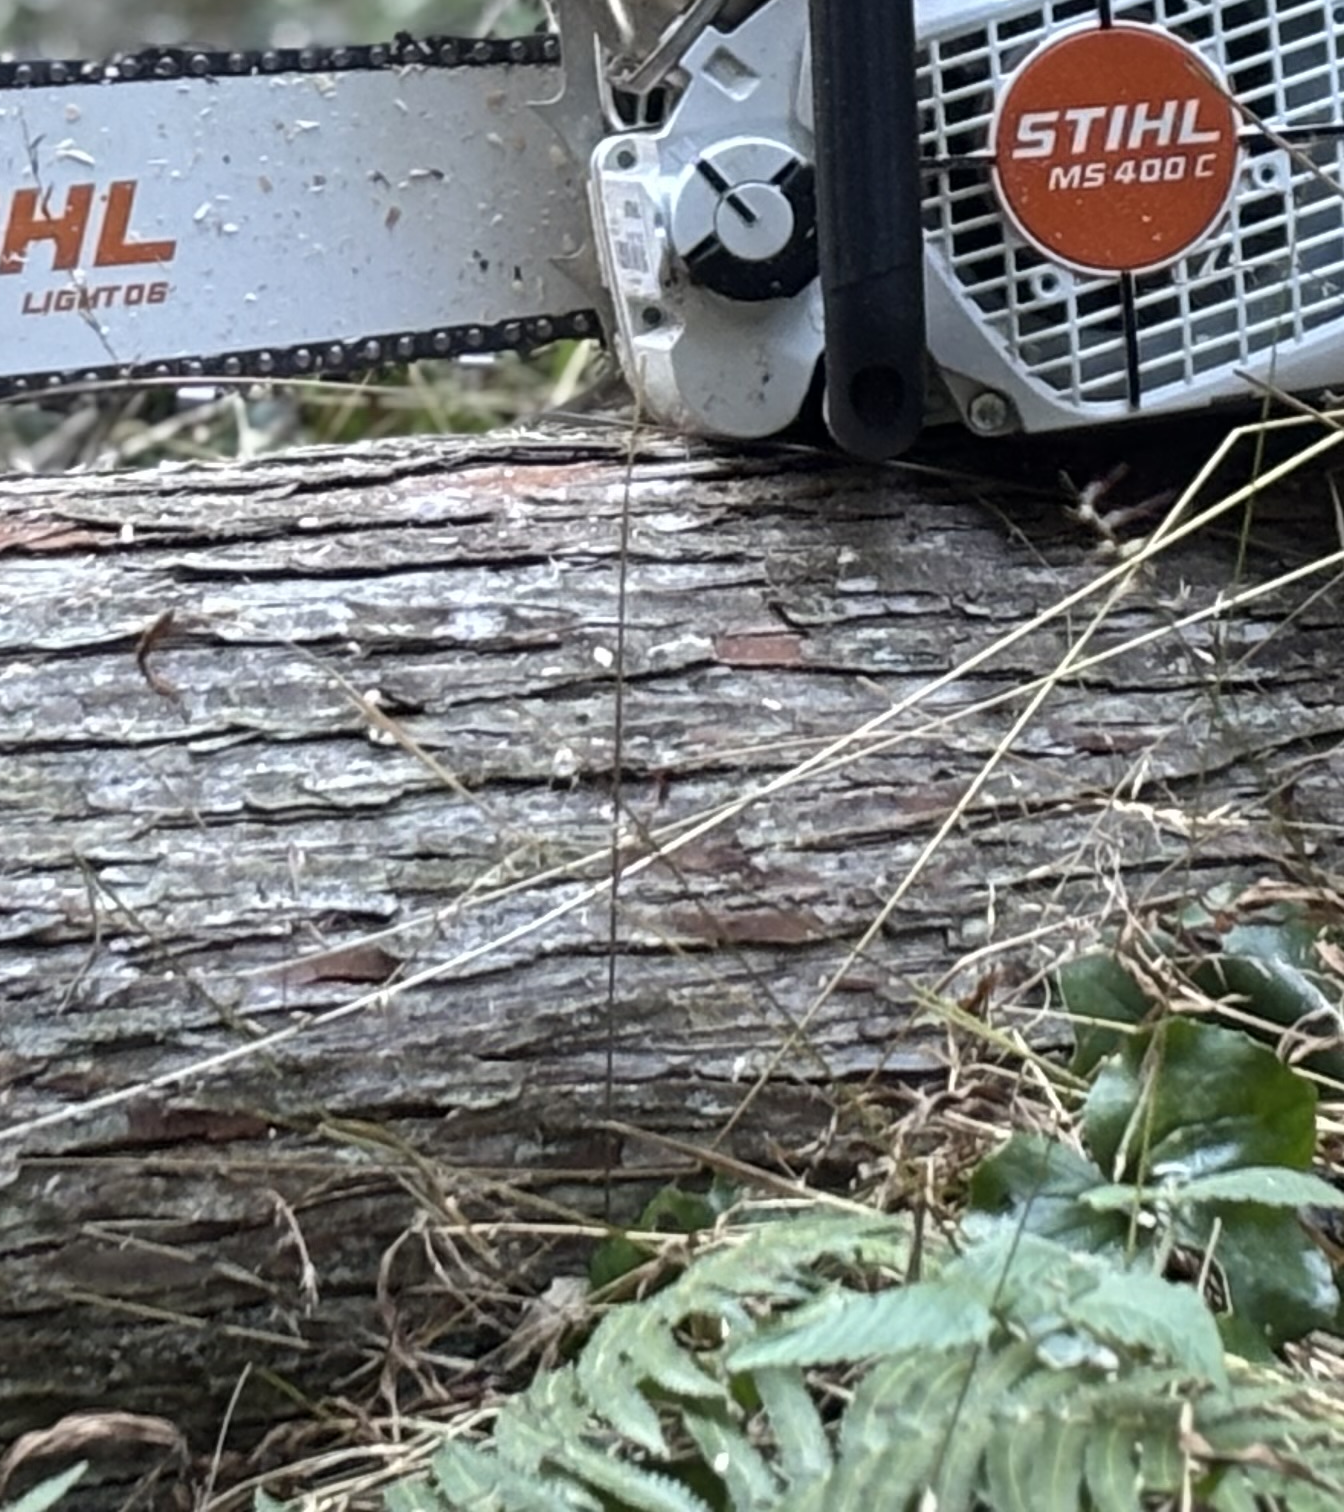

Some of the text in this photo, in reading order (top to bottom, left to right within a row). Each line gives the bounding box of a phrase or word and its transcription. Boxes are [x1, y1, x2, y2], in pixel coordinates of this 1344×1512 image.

[1012, 98, 1221, 159] STIHL
[1049, 153, 1217, 191] MS 400 C
